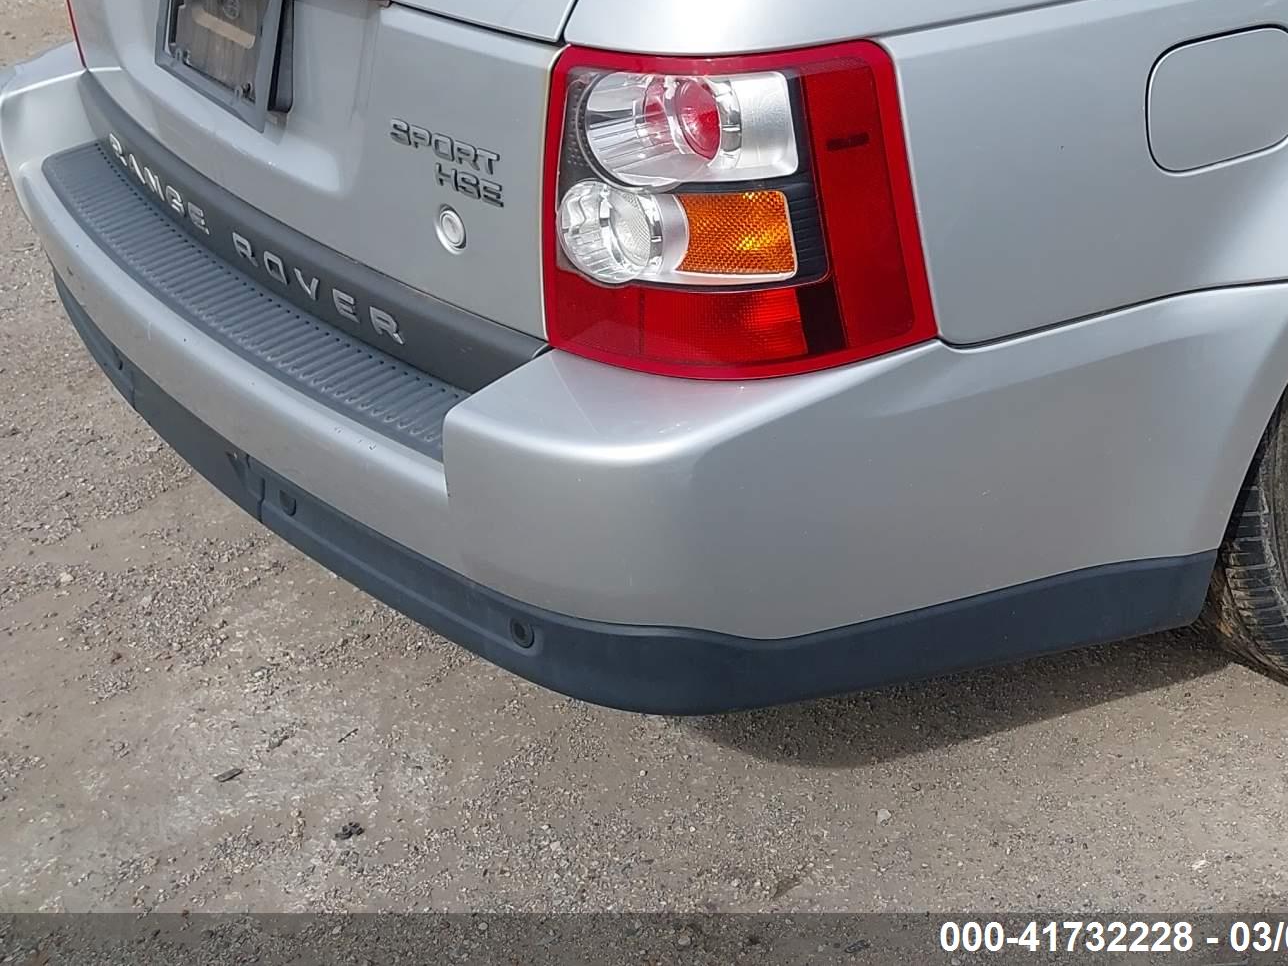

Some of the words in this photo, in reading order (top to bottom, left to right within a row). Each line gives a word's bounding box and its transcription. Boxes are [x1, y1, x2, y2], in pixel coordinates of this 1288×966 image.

[389, 117, 500, 175] SPORT
[435, 162, 504, 207] HSE
[109, 132, 210, 235] RANGE
[232, 231, 405, 345] ROVER
